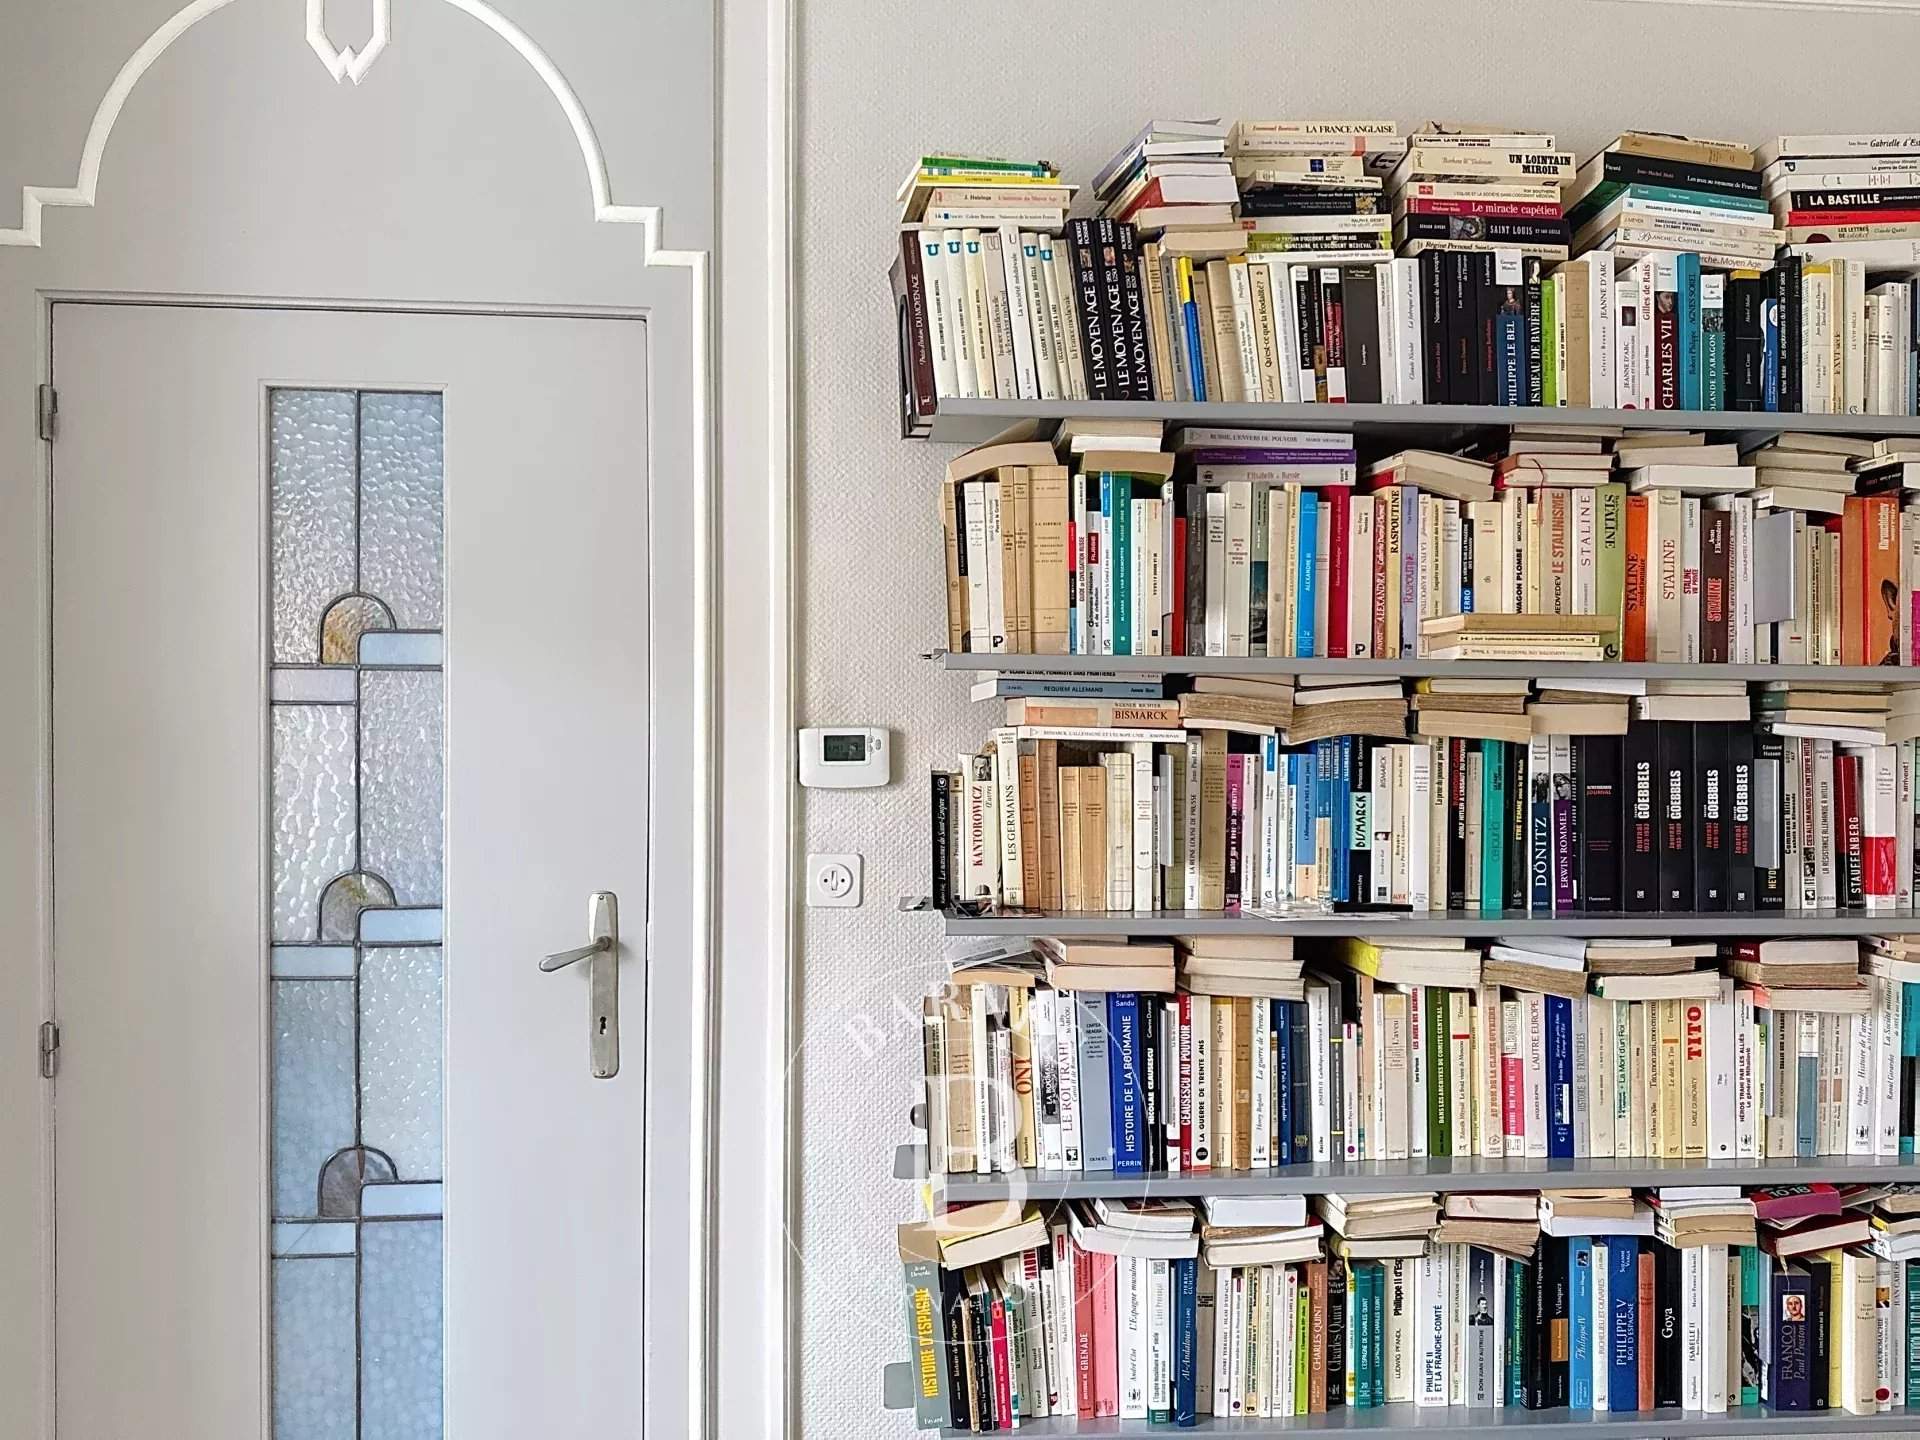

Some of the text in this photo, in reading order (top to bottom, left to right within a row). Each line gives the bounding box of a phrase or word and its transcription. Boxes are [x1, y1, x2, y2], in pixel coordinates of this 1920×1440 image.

[1306, 125, 1394, 133] LA FRANCE ANGLAISE
[1870, 138, 1900, 148] Gabrielle
[1509, 155, 1571, 166] UN LOINTAIN
[1522, 165, 1559, 175] MIROIR
[1472, 203, 1558, 217] Le miracle capétien
[1810, 194, 1880, 206] LA BASTILLE
[925, 243, 940, 256] U
[948, 242, 961, 254] U
[966, 242, 979, 254] U
[1490, 226, 1533, 236] SAINT LOUIS
[1720, 257, 1762, 268] Moyen Age
[911, 273, 926, 328] DU MOYEN AGE
[1600, 261, 1608, 319] JEANNE D'ARC
[1642, 264, 1651, 321] Gilles de Rais
[1688, 273, 1697, 325] AGNES SOREL
[1084, 286, 1108, 388] LE MOYEN AGE
[1108, 285, 1130, 386] LE MOYEN AGE
[1127, 291, 1149, 392] LE MOYEN AGE
[1263, 323, 1271, 337] que
[1264, 337, 1273, 368] Qu'est-ce
[1528, 302, 1542, 403] ISABEAU DE BAVIÈRE
[1506, 320, 1518, 407] PHILIPPE LE BEL
[1623, 362, 1631, 389] JEANNE
[1661, 319, 1674, 409] CHARLES VII
[1708, 334, 1717, 377] D'ARAGON
[1390, 490, 1400, 554] RASPOUTINE
[1552, 492, 1564, 558] STALINISME
[1580, 495, 1591, 566] STALINE
[1604, 494, 1616, 549] STALINE
[1714, 520, 1723, 554] Elleinstein
[1404, 553, 1415, 603] RASPOUTINE
[1552, 561, 1564, 574] LE
[1627, 553, 1638, 612] STALINE
[1663, 539, 1675, 600] STALINE
[1684, 568, 1692, 594] STALINE
[1376, 571, 1385, 623] ALEXANDRA
[1707, 577, 1721, 621] STALINE
[1115, 711, 1168, 720] BISMARCK
[1638, 762, 1650, 819] GOEBBELS
[1670, 770, 1682, 819] GOEBBELS
[1707, 770, 1719, 819] GOEBBELS
[1736, 765, 1749, 822] GOEBBELS
[1821, 781, 1829, 799] HITLER
[972, 785, 984, 867] KANTOROWICZ
[1005, 785, 1017, 861] LES GERMAINS
[1356, 795, 1367, 848] BISMARCK
[1821, 805, 1829, 835] ALLEMANDE
[1533, 817, 1547, 887] DÖNITZ
[1559, 810, 1569, 888] ERWIN ROMMEL
[1821, 835, 1830, 867] RÉSISTANCE
[1822, 867, 1830, 875] LA
[1849, 816, 1861, 894] STAUFFENBERG
[1391, 1020, 1399, 1045] L'aveu
[1531, 1000, 1540, 1071] L'AUTRE EUROPE
[1688, 1006, 1702, 1060] TITO
[1014, 1058, 1032, 1095] ONI
[1058, 1042, 1074, 1132] LE ROI TRAHI
[1122, 1015, 1135, 1152] HISTOIRE DE LA ROUMANIE
[1180, 1024, 1191, 1126] CEAUSESCU AU POUVOIR
[1198, 1088, 1204, 1097] DE
[1576, 1033, 1586, 1112] HISTOIRE DE FRONTIÈRES
[1147, 1091, 1155, 1125] NICOLAE
[1199, 1133, 1205, 1142] LA
[1394, 1286, 1404, 1316] Philippe
[1556, 1283, 1564, 1315] Vélasquez
[1662, 1307, 1675, 1339] Goya
[915, 1288, 939, 1397] HISTOIRE D'ESPAGNE
[1313, 1305, 1322, 1370] CHARLES QUINT
[1433, 1305, 1442, 1393] ET LA FRANCHE-COMTÉ
[1616, 1298, 1628, 1366] PHILIPPE V
[1689, 1322, 1696, 1330] II
[1080, 1333, 1089, 1371] GRENADE
[1181, 1330, 1191, 1381] Al-Andalous
[1426, 1359, 1434, 1393] PHILIPPE
[1782, 1325, 1793, 1380] FRANCO
[1795, 1325, 1806, 1379] Paul Preston
